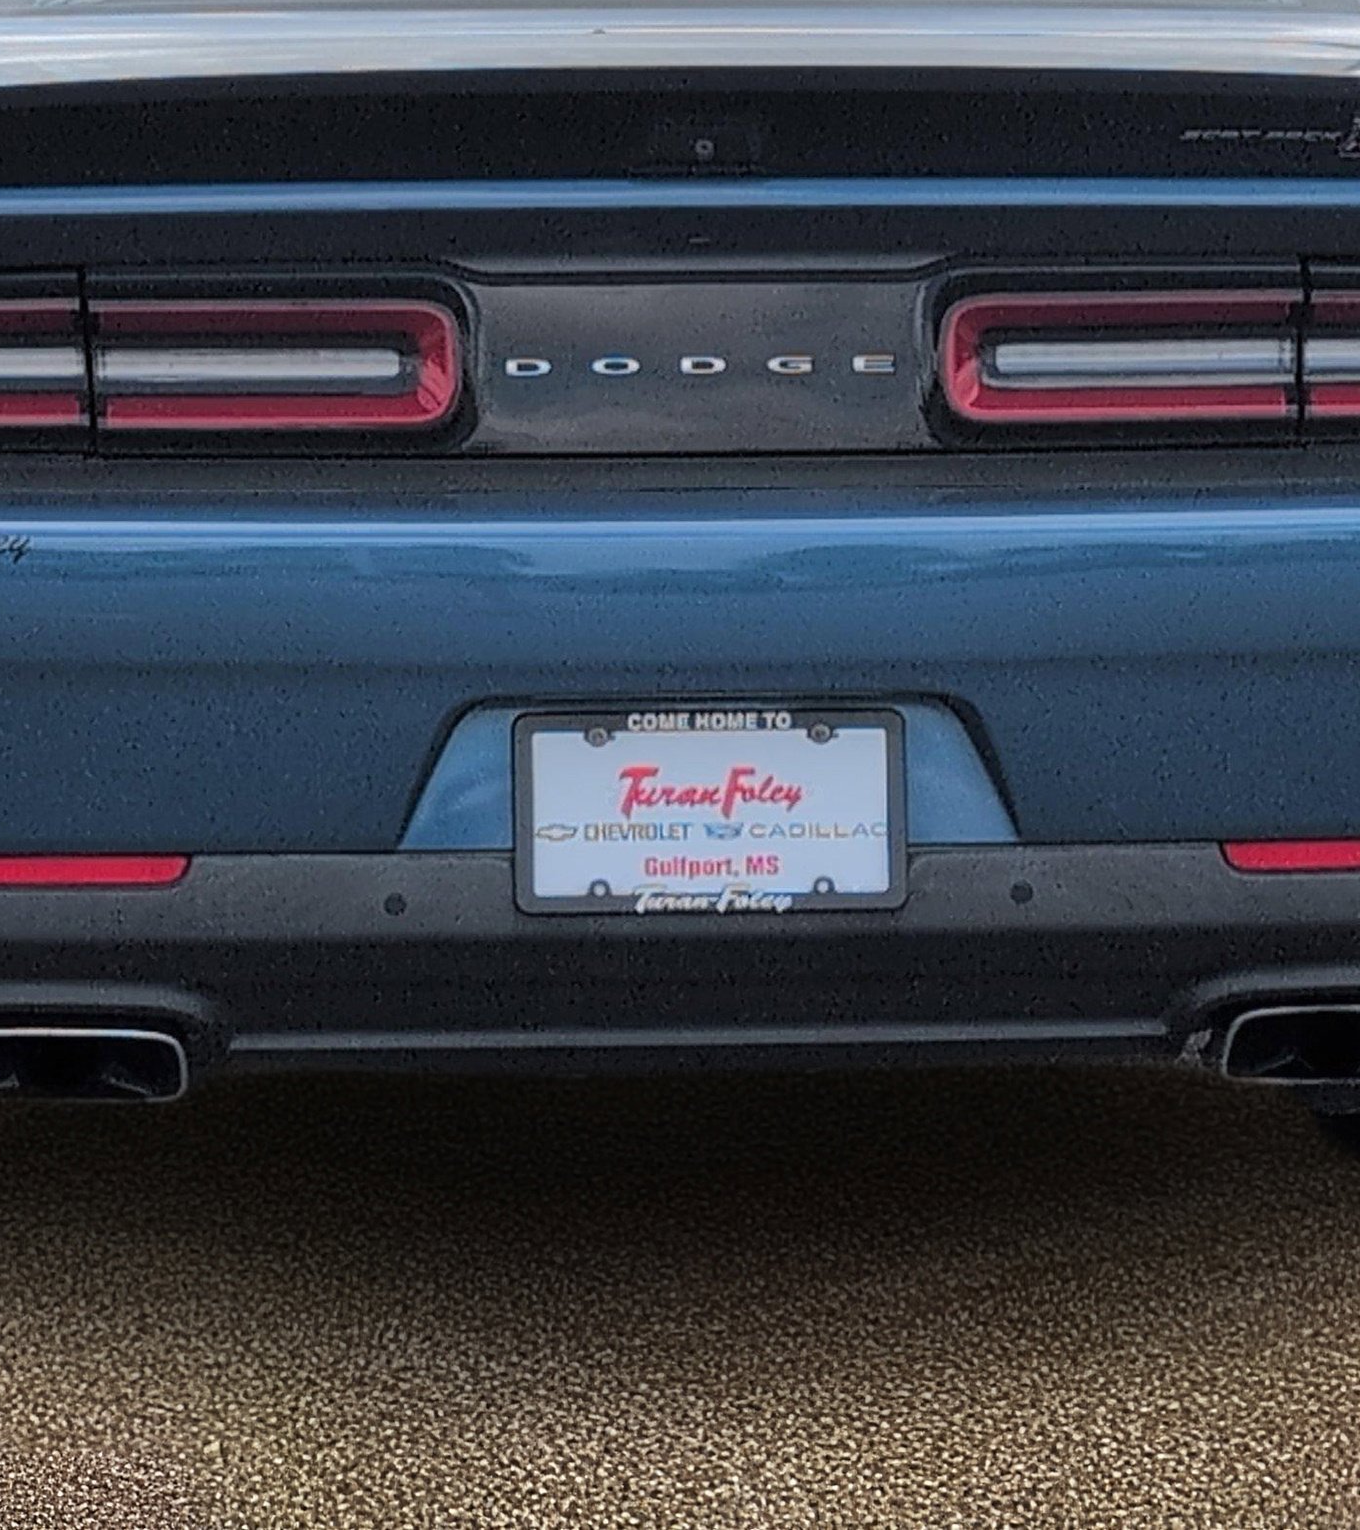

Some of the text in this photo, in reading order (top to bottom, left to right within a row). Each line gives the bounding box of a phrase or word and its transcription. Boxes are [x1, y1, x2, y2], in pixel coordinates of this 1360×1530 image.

[504, 353, 895, 377] DODGE
[626, 710, 792, 731] COME HOME TO
[617, 766, 803, 820] Turan Foley
[582, 821, 889, 842] CHEVROLET CADILLAC
[643, 855, 780, 879] Gulfport, MS
